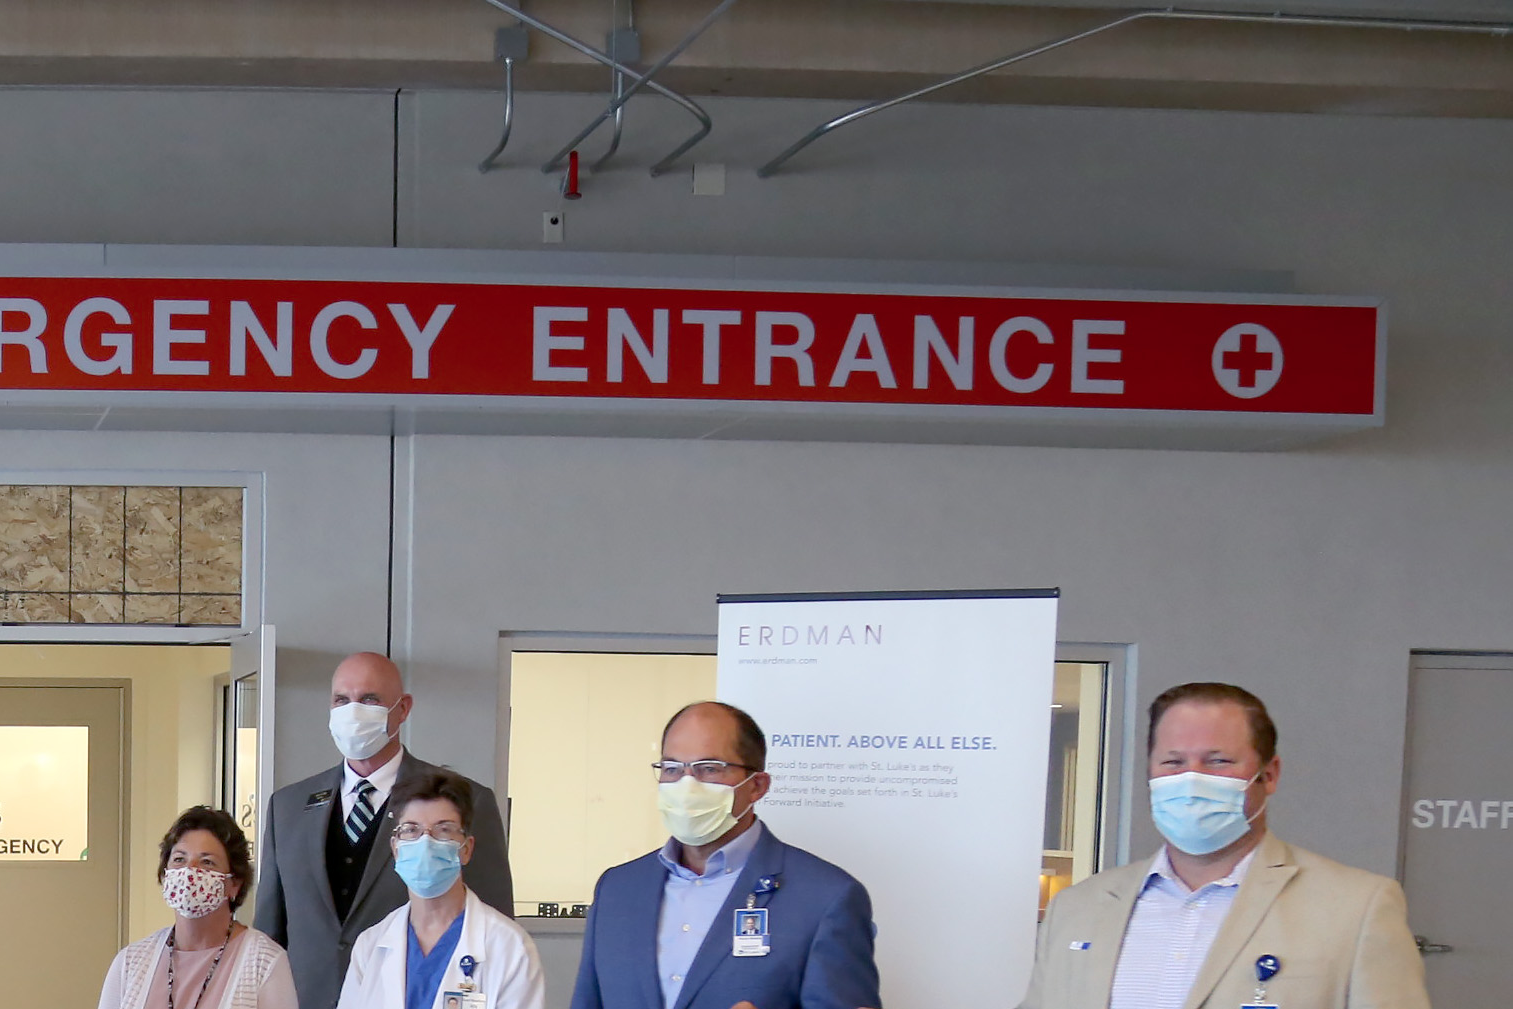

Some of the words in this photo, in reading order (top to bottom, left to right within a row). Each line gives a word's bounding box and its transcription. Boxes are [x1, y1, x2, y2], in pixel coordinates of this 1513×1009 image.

[532, 306, 1124, 394] ENTRANCE
[738, 624, 882, 646] ERDMAN
[738, 656, 818, 665] www.erdman.com
[771, 734, 842, 748] PATIENT.
[847, 735, 908, 749] ABOVE
[913, 736, 945, 750] ALL
[951, 737, 997, 750] ELSE.
[767, 761, 795, 770] proud
[811, 762, 844, 770] partner
[848, 762, 868, 770] with
[870, 762, 884, 770] St.
[887, 762, 916, 771] Luke's
[933, 763, 954, 773] they
[840, 775, 876, 784] provide
[879, 777, 958, 785] uncompromised
[773, 786, 808, 794] achieve
[829, 787, 854, 797] goals
[875, 788, 897, 796] forth
[929, 789, 958, 798] Luke's
[764, 797, 801, 806] Forward
[804, 799, 845, 807] Initiative.
[1412, 799, 1513, 829] STAFF
